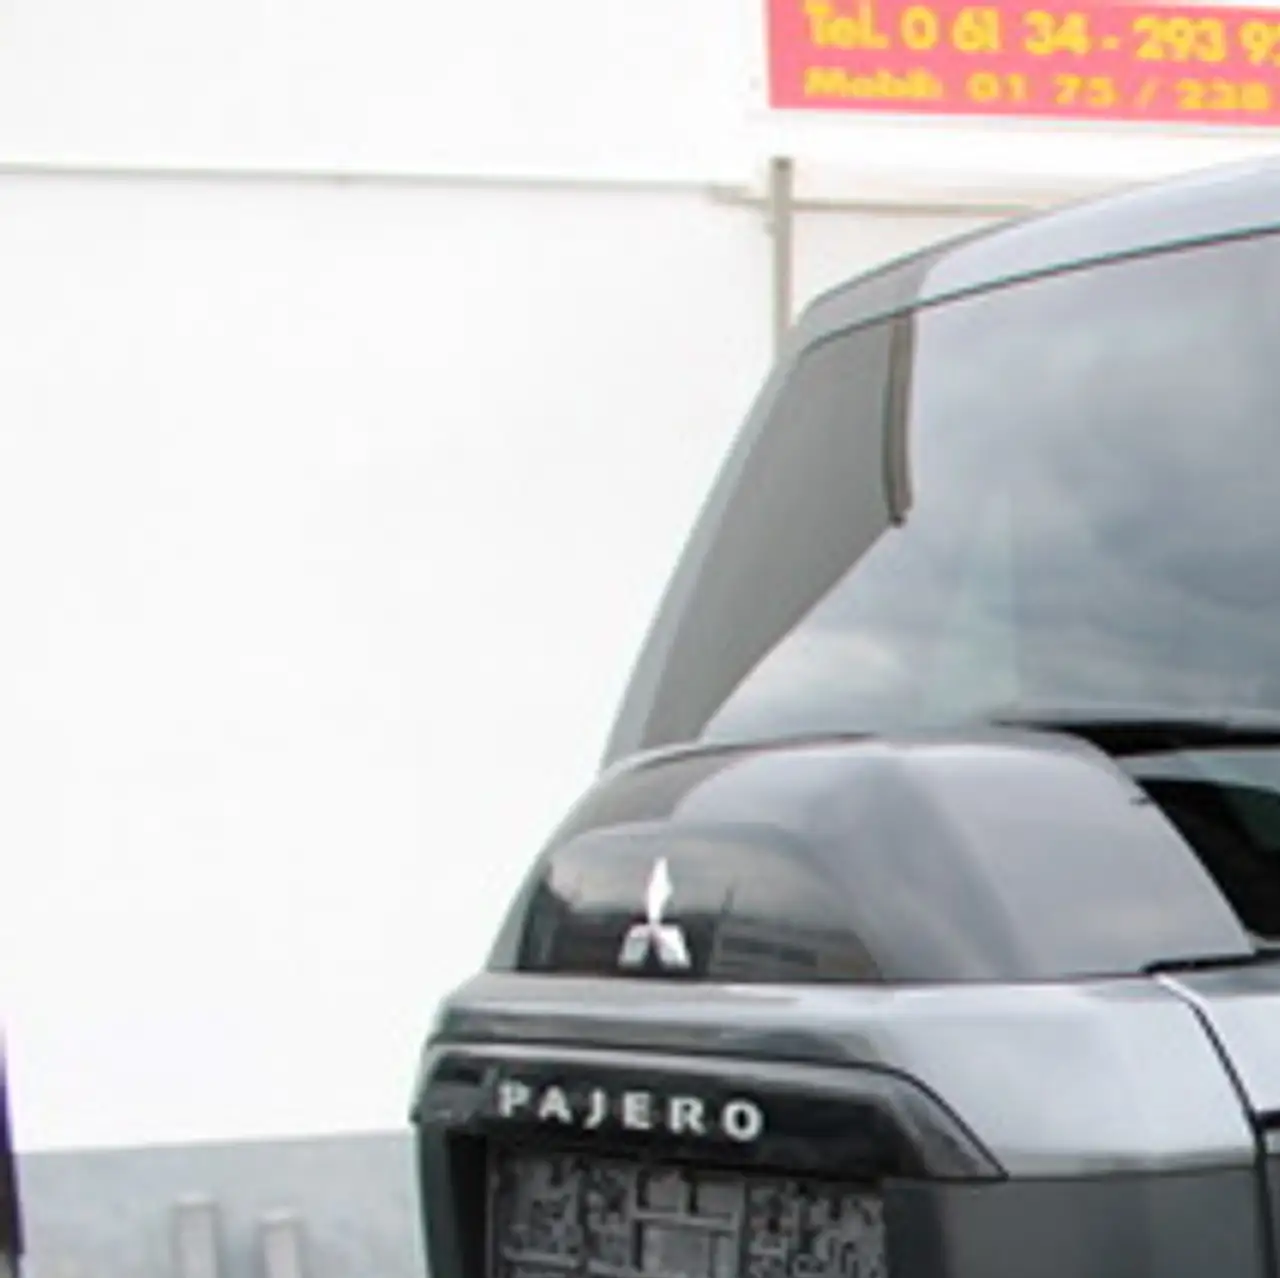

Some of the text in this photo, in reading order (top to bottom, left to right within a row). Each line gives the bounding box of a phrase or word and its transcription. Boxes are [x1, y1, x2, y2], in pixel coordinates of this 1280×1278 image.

[900, 5, 940, 51] 0
[949, 7, 1003, 54] 61
[1022, 9, 1093, 56] 34
[1131, 14, 1228, 64] 293
[498, 1083, 763, 1141] PAJERO
